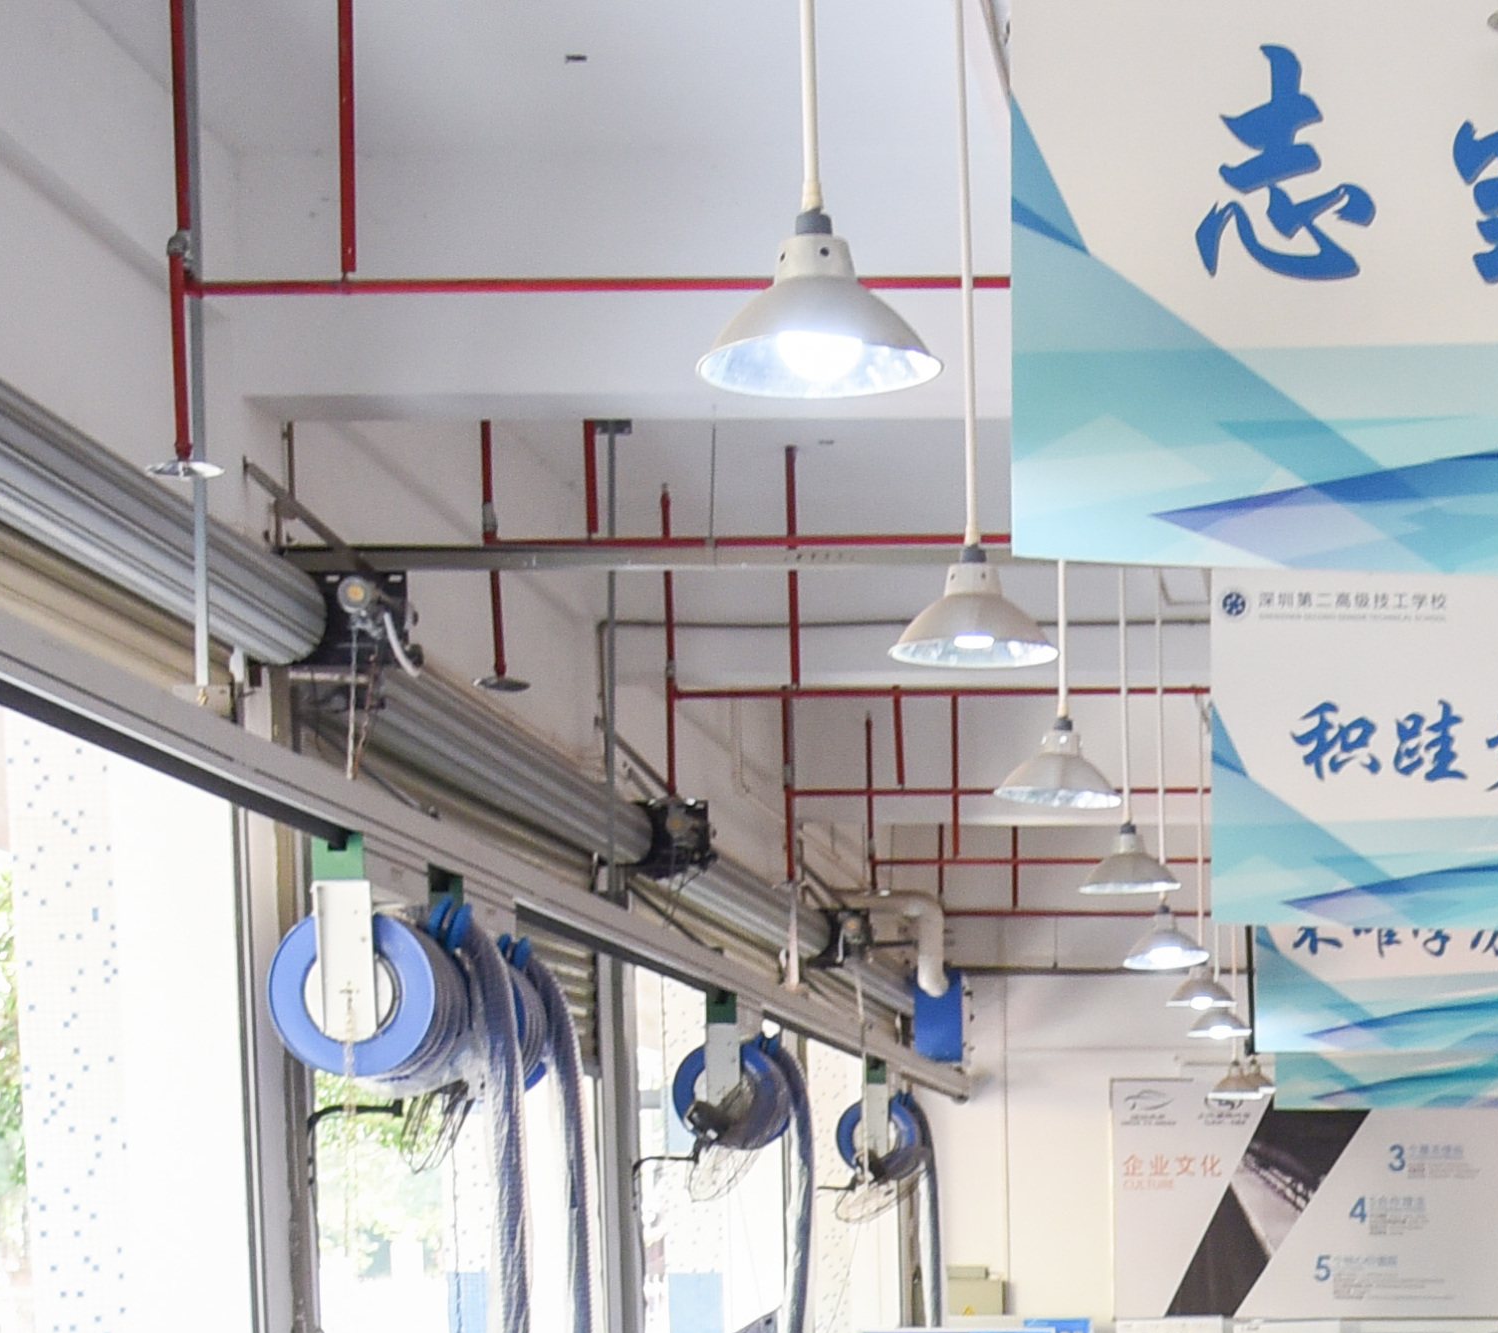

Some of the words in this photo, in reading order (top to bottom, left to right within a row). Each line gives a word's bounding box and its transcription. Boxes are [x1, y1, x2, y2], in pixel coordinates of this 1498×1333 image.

[1122, 1153, 1223, 1178] 企业文化
[1388, 1144, 1406, 1172] 3
[1349, 1197, 1367, 1224] 4
[1313, 1254, 1332, 1282] 5
